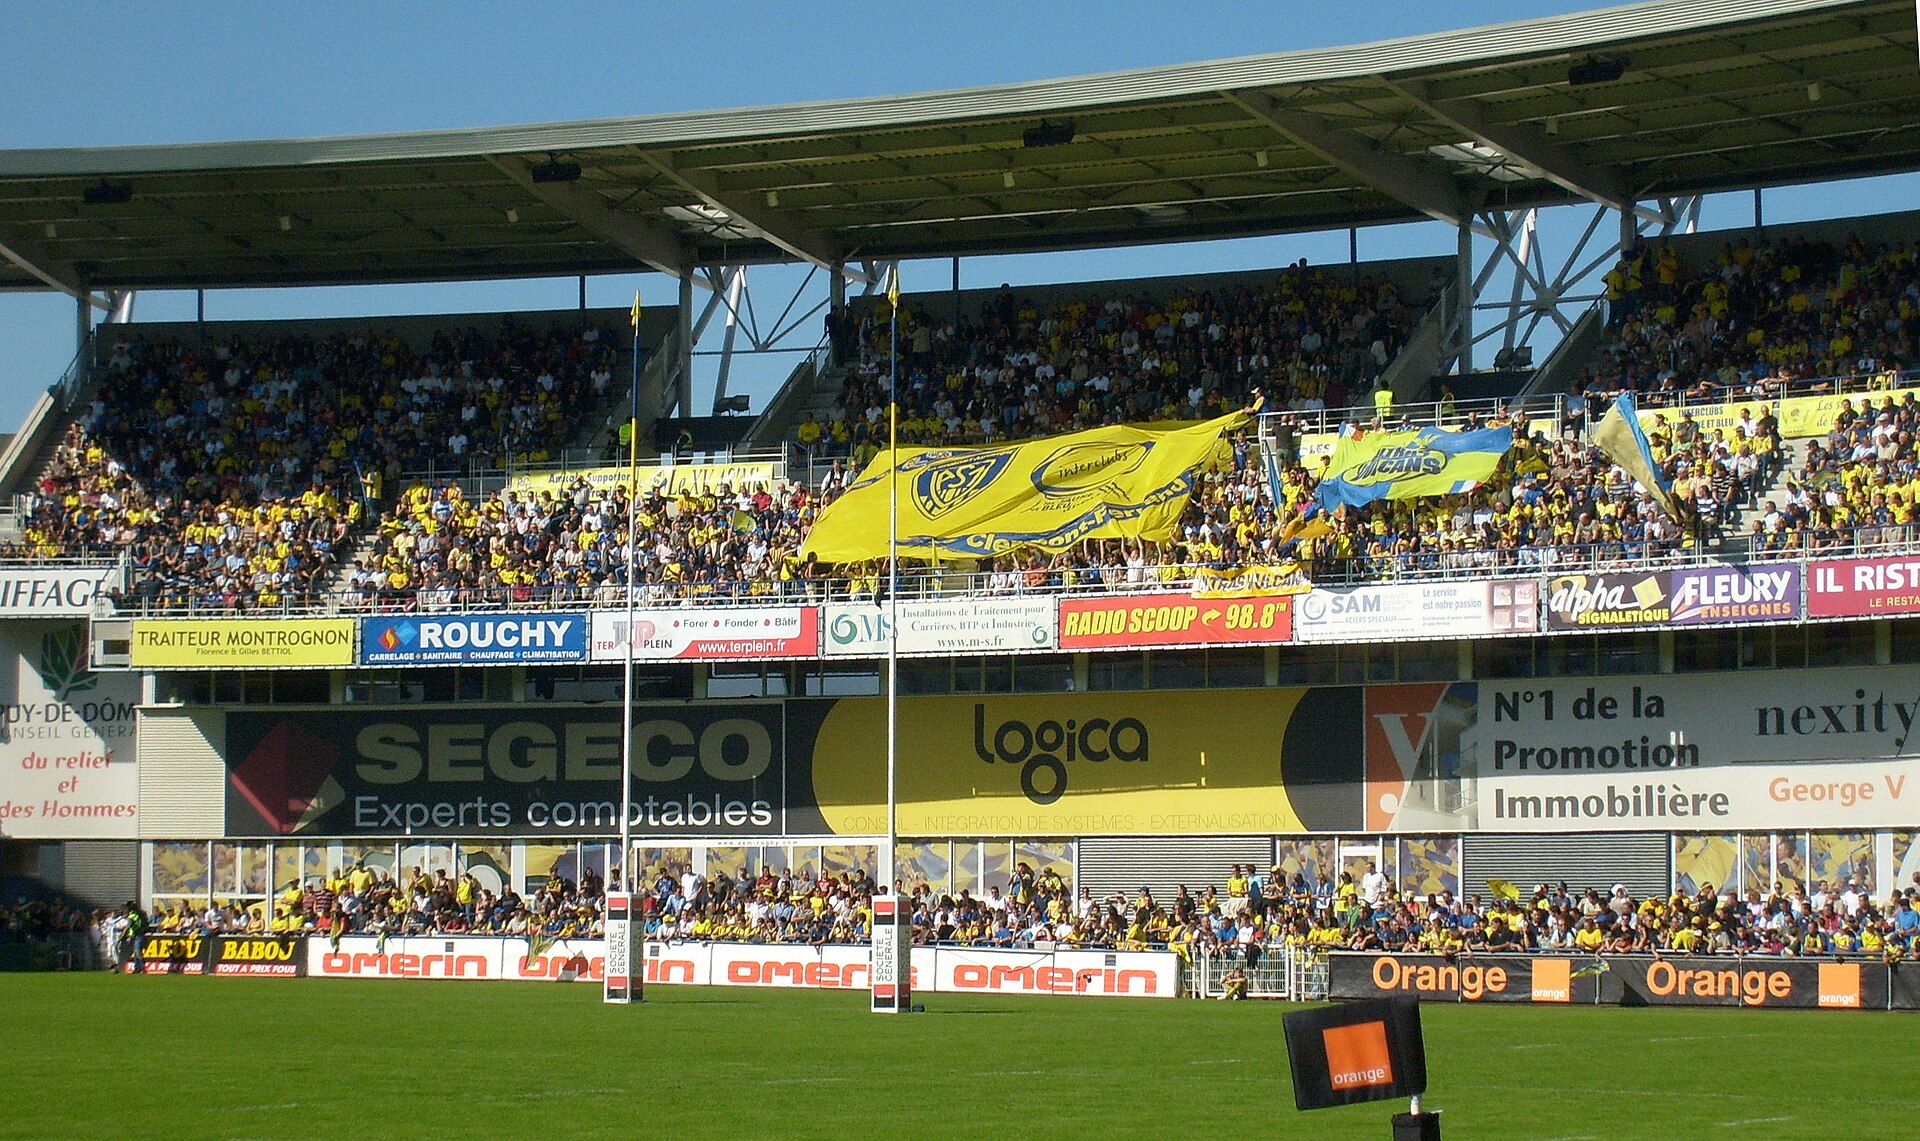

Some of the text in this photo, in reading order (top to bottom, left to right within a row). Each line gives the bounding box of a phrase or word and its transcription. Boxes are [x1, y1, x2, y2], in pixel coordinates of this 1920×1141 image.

[1716, 418, 1733, 427] BLEU
[1059, 449, 1128, 479] interclubs
[1816, 562, 1920, 593] IL RIST
[1422, 588, 1457, 597] Le service
[1684, 570, 1792, 606] FLEURY
[1331, 595, 1381, 614] SAM
[1422, 599, 1482, 610] est notre passion
[1551, 578, 1640, 621] alpha
[1869, 597, 1882, 608] LE
[902, 604, 1046, 618] Installations de Traitement pour
[1064, 602, 1287, 636] RADIO SCOOP 98.8 FM
[1578, 608, 1670, 625] SIGNALETIQUE
[1701, 602, 1791, 619] ENSEIGNES
[683, 617, 798, 628] Forer Fonder Bâtir
[959, 621, 979, 630] BTP
[981, 621, 989, 630] et
[991, 618, 1036, 629] Industries
[138, 629, 349, 647] TRAITEUR MONTROGNON
[419, 620, 572, 649] ROUCHY
[937, 636, 1004, 648] www.m-s.fr
[262, 647, 292, 655] BETTIOL
[596, 639, 673, 650] TER PLEIN
[698, 639, 787, 655] www.terplein.fr
[369, 650, 580, 661] CARRELAGE SANITAIRE CHAUFFAGE CLIMATISATION
[1495, 686, 1665, 722] N°1 de la
[1755, 688, 1920, 757] nexity
[22, 750, 115, 769] du relief
[355, 719, 772, 784] SEGECO
[975, 704, 1148, 805] logica
[1494, 735, 1699, 770] Promotion
[58, 775, 79, 793] et
[1768, 774, 1906, 807] George V
[0, 800, 136, 819] des Hommes
[1495, 783, 1729, 819] Immobilière
[354, 793, 773, 834] Experts comptables
[843, 815, 908, 831] CONSIL
[1027, 815, 1047, 830] DE
[1150, 813, 1287, 830] EXTERNALISATION
[609, 932, 617, 974] SOCIETE
[617, 922, 626, 974] GENERALE
[884, 928, 893, 982] GENERALE
[217, 964, 240, 973] TOUT
[250, 964, 270, 973] PRIX
[271, 964, 296, 973] FOUS
[322, 942, 487, 977] omerin
[518, 946, 694, 983] omein
[876, 938, 884, 981] SOCIETE
[953, 954, 1157, 994] omerin
[1372, 956, 1507, 1000] Orange
[1646, 960, 1792, 1006] Orange
[1532, 989, 1565, 999] orange
[1819, 994, 1855, 1004] orange
[1333, 1067, 1385, 1085] orange
